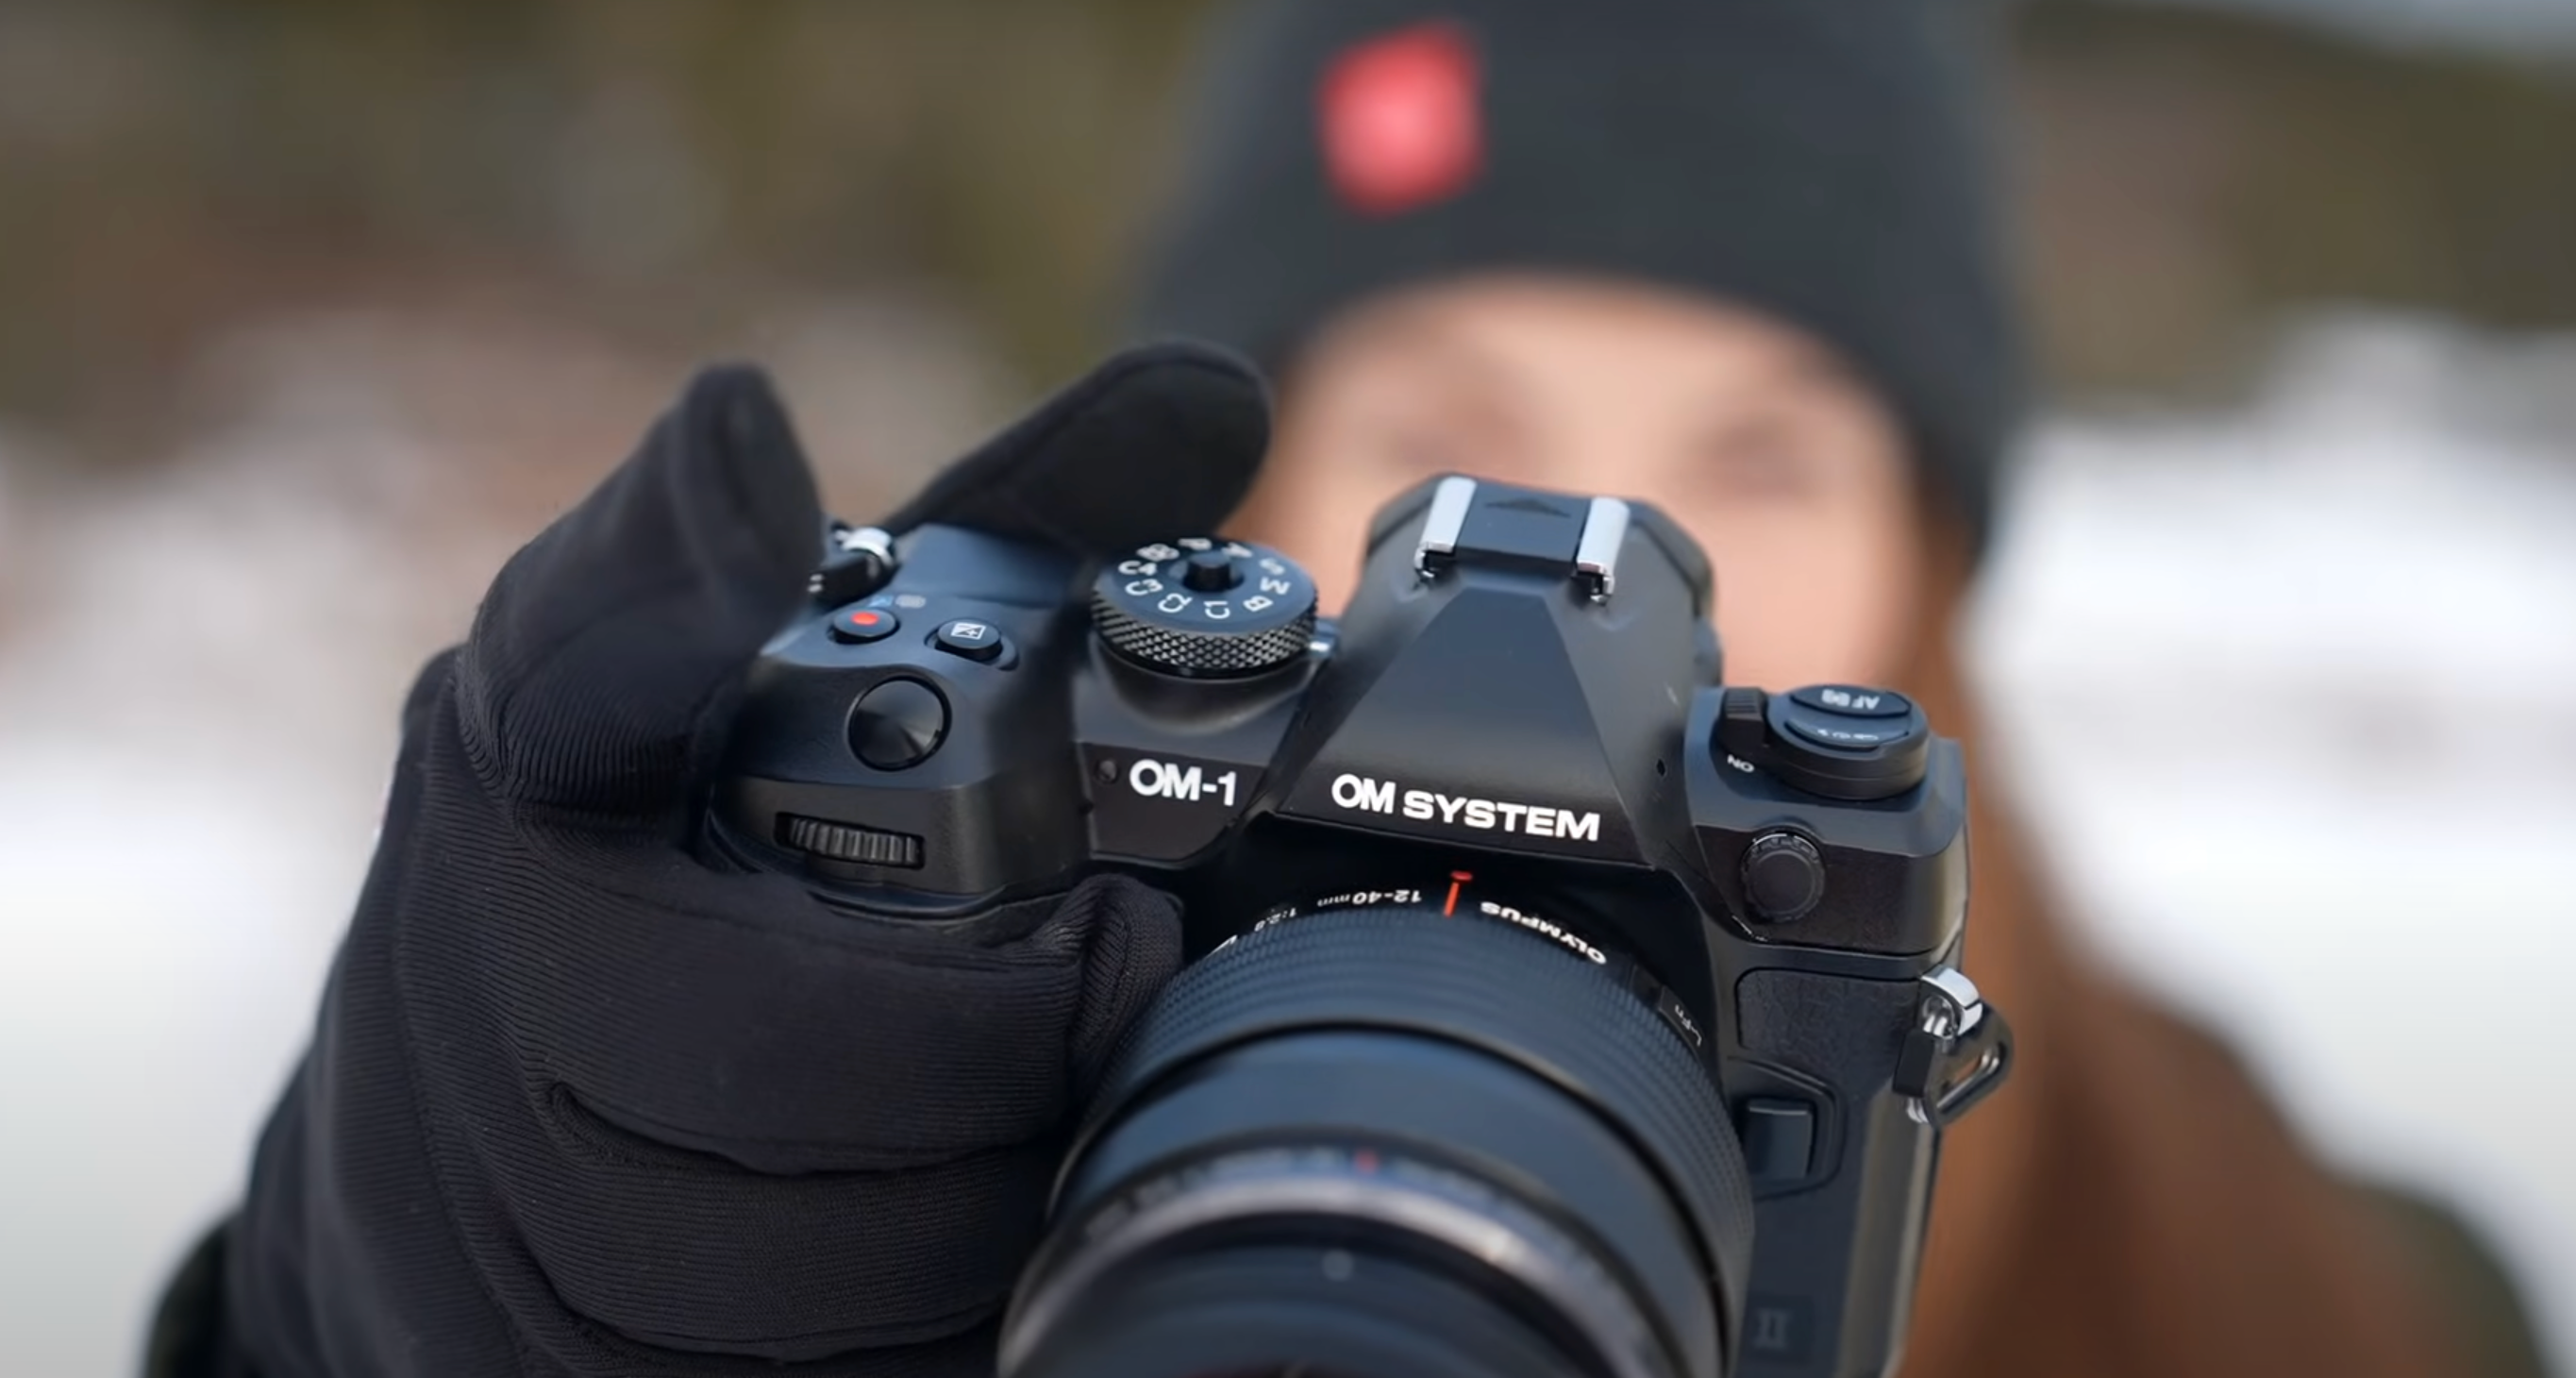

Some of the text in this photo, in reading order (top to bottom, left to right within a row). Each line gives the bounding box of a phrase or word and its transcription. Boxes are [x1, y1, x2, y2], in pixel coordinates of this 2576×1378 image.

[1118, 561, 1158, 575] C4
[1260, 558, 1285, 575] S
[1125, 579, 1163, 597] C3
[1158, 593, 1192, 613] C2
[1204, 600, 1230, 619] C1
[1243, 596, 1273, 612] B
[1851, 696, 1881, 710] AF
[1727, 754, 1755, 773] ON
[1129, 759, 1238, 806] OM-1
[1331, 773, 1600, 842] OM SYSTEM
[1480, 900, 1607, 965] OLYMPUS
